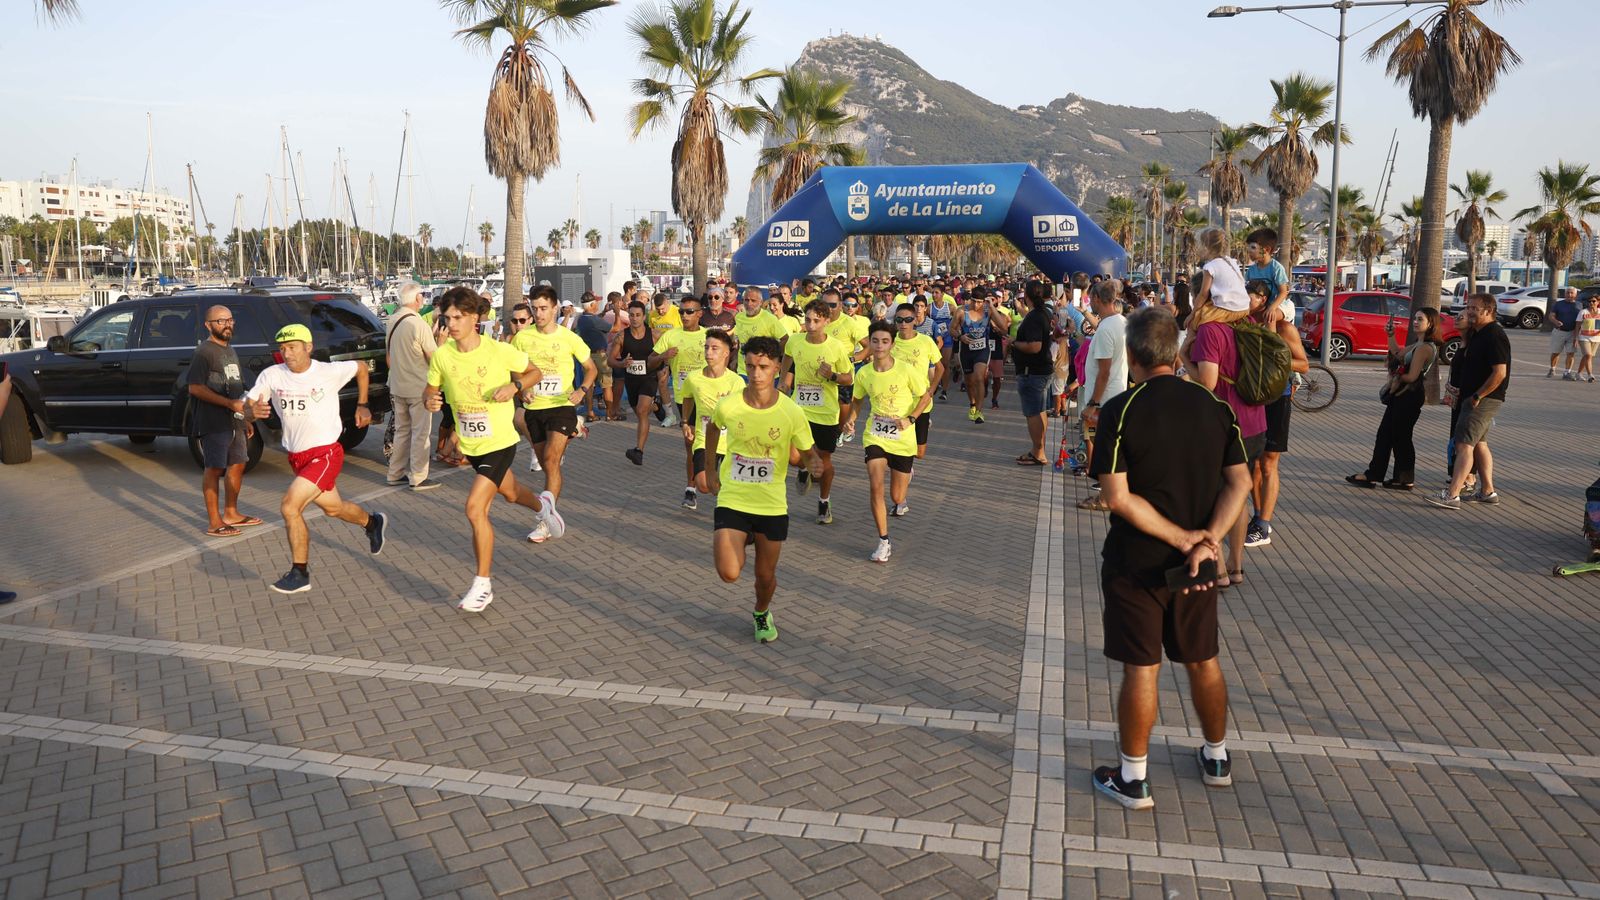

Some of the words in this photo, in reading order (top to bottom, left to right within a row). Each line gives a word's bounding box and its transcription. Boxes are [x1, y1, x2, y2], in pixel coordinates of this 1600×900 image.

[874, 181, 996, 201] Ayuntamiento
[888, 201, 908, 217] de
[912, 202, 933, 217] La
[935, 201, 983, 216] Línea
[772, 226, 783, 238] D
[1038, 220, 1050, 234] D
[766, 248, 809, 256] DEPORTES
[1034, 243, 1080, 252] DEPORTES
[537, 382, 558, 391] 177
[799, 391, 820, 402] 873
[280, 398, 306, 411] 915
[460, 421, 486, 432] 756
[875, 422, 897, 435] 342
[737, 462, 768, 477] 716
